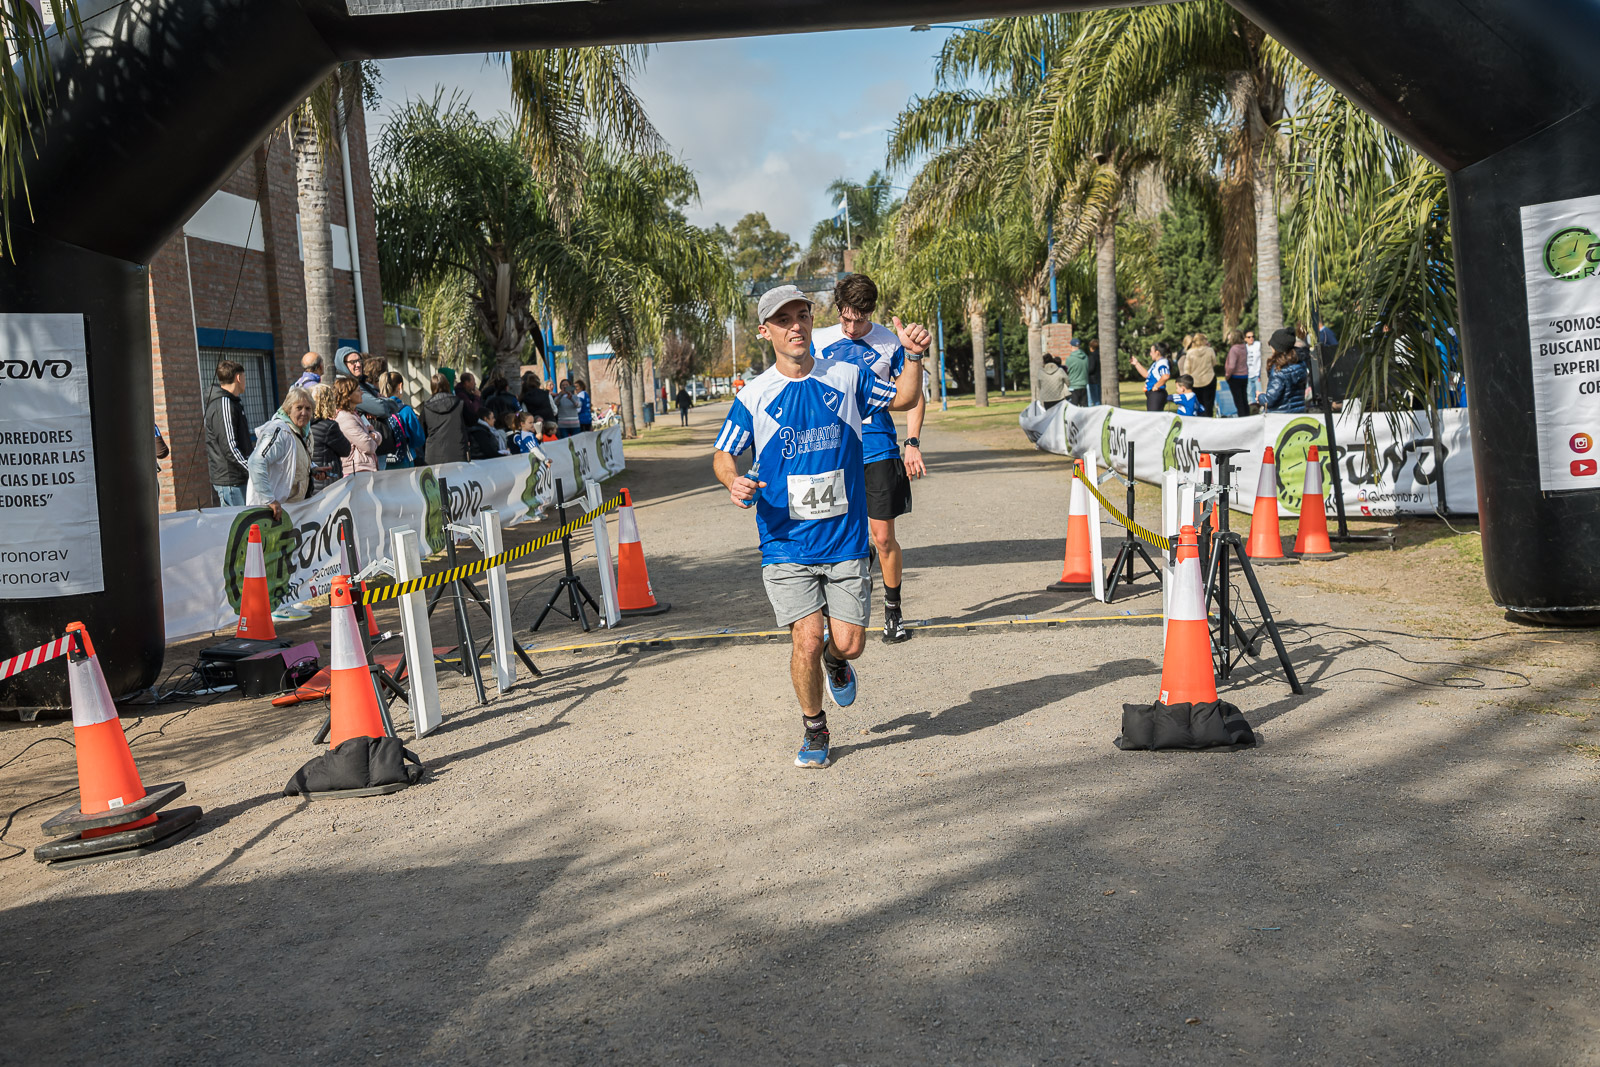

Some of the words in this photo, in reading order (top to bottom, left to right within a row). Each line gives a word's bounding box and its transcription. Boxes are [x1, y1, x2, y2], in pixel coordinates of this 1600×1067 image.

[1540, 338, 1600, 357] BUSCAND
[779, 426, 797, 460] 3
[0, 452, 59, 466] MEJORAR
[63, 450, 86, 463] LAS
[32, 473, 49, 487] DE
[52, 471, 75, 485] LOS
[801, 484, 837, 509] 44
[0, 571, 70, 585] ronorav
